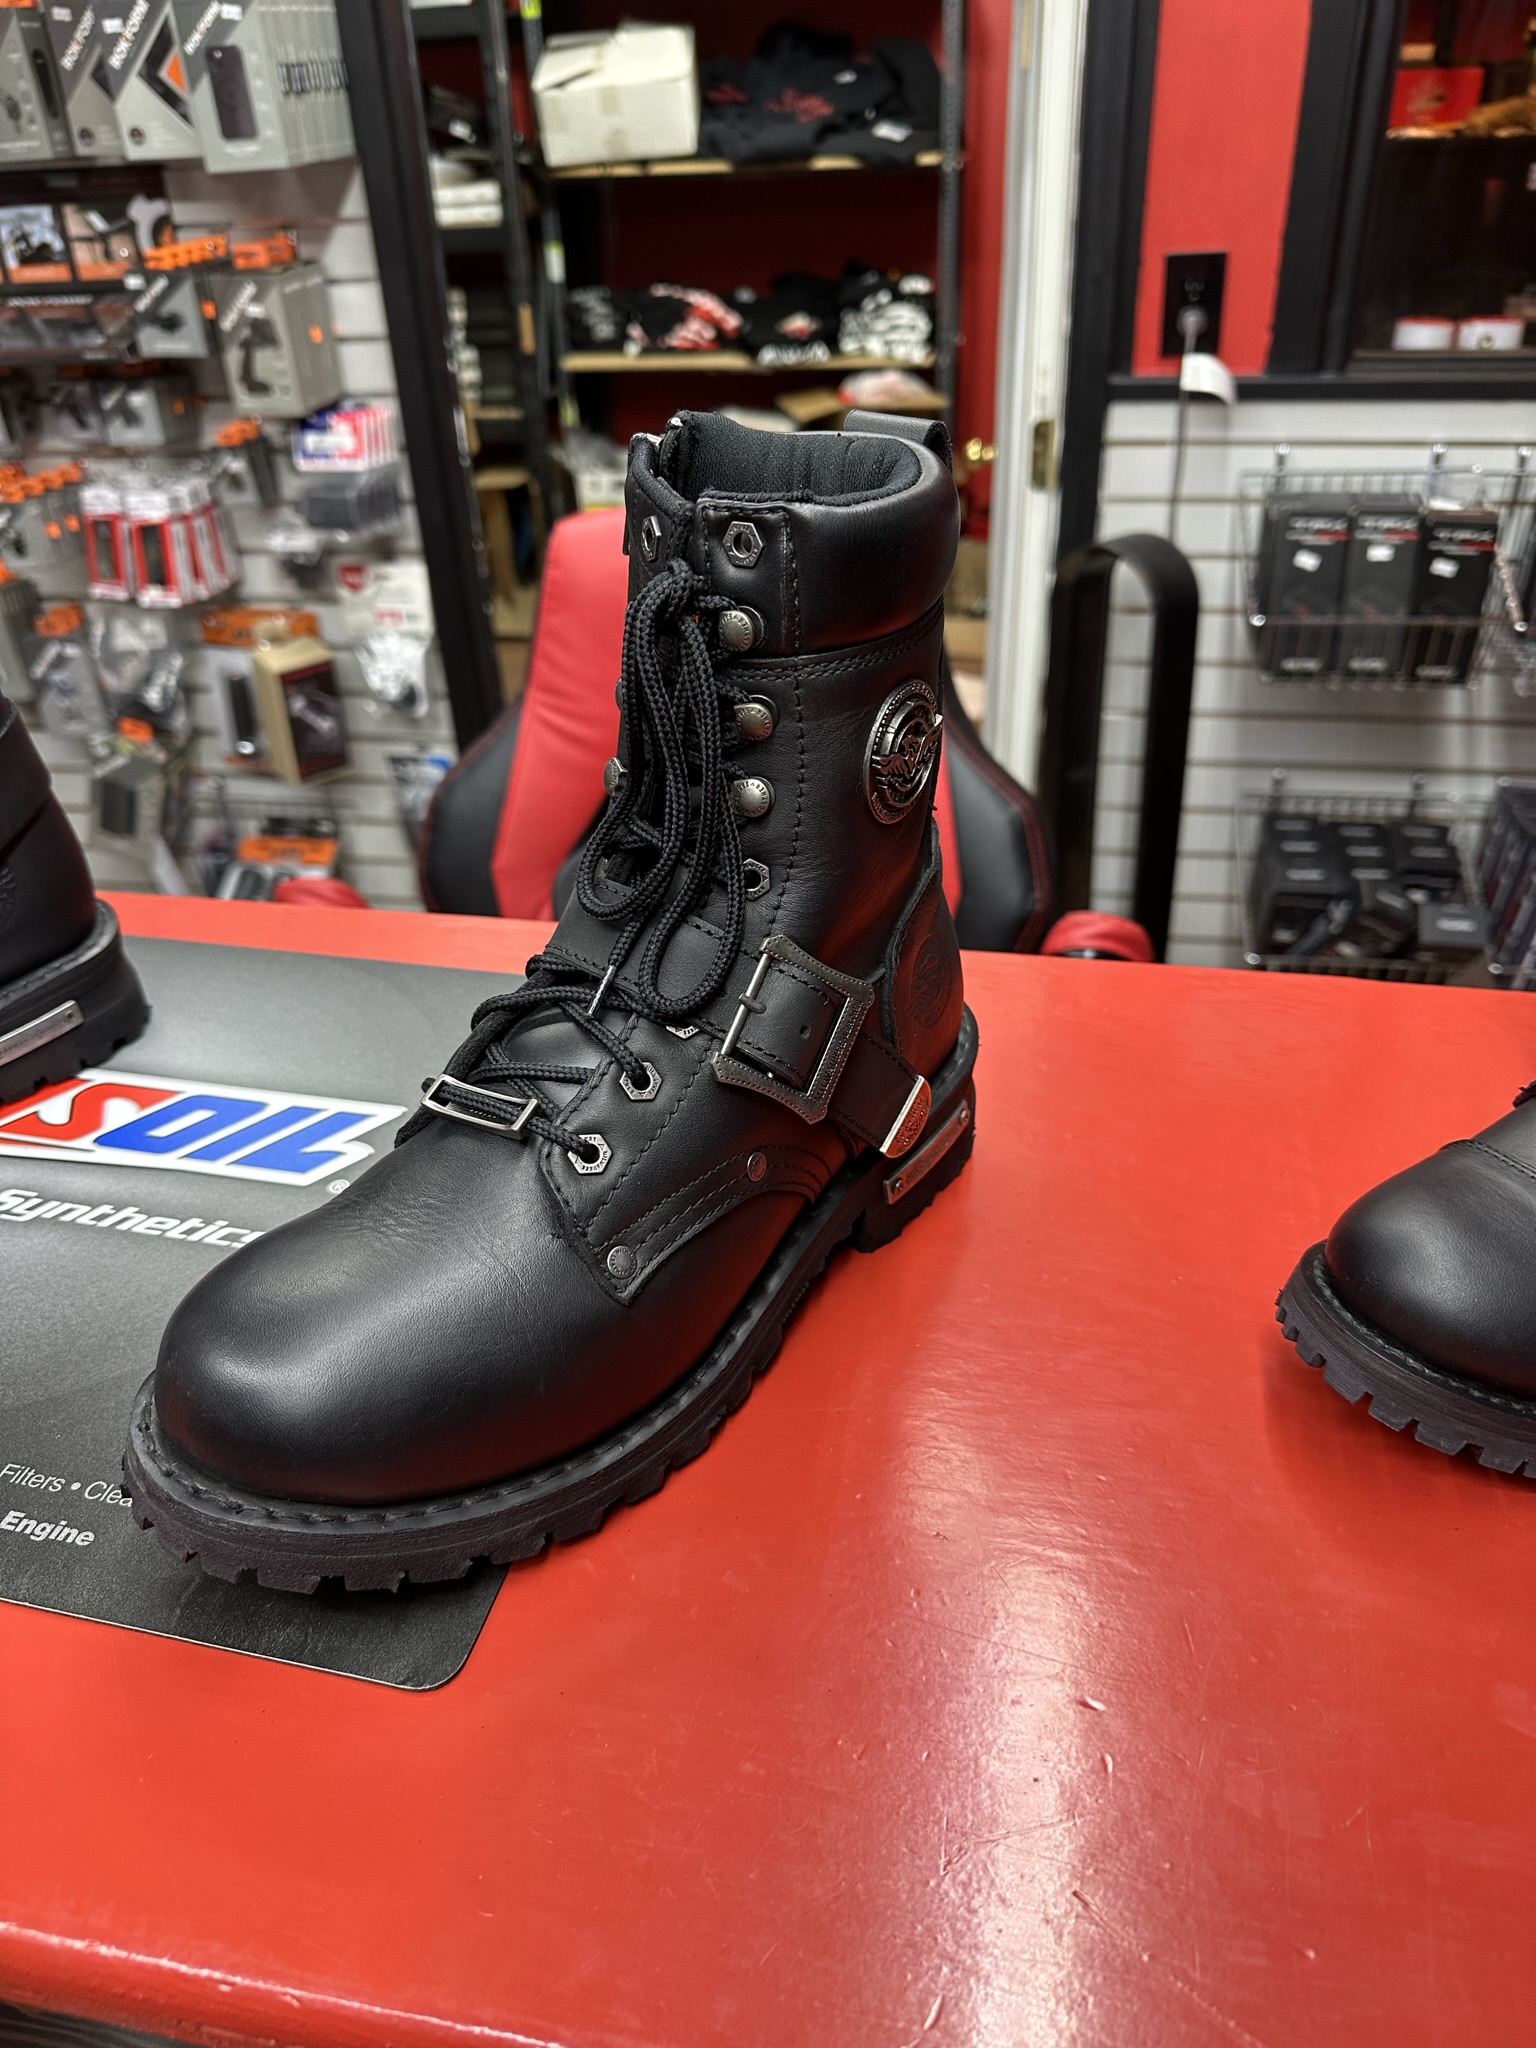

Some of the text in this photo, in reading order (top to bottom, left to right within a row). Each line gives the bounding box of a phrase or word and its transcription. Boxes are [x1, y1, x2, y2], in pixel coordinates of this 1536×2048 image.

[0, 1081, 376, 1174] SOIL
[0, 1463, 133, 1508] Filters Clea
[0, 1510, 95, 1546] Engine
